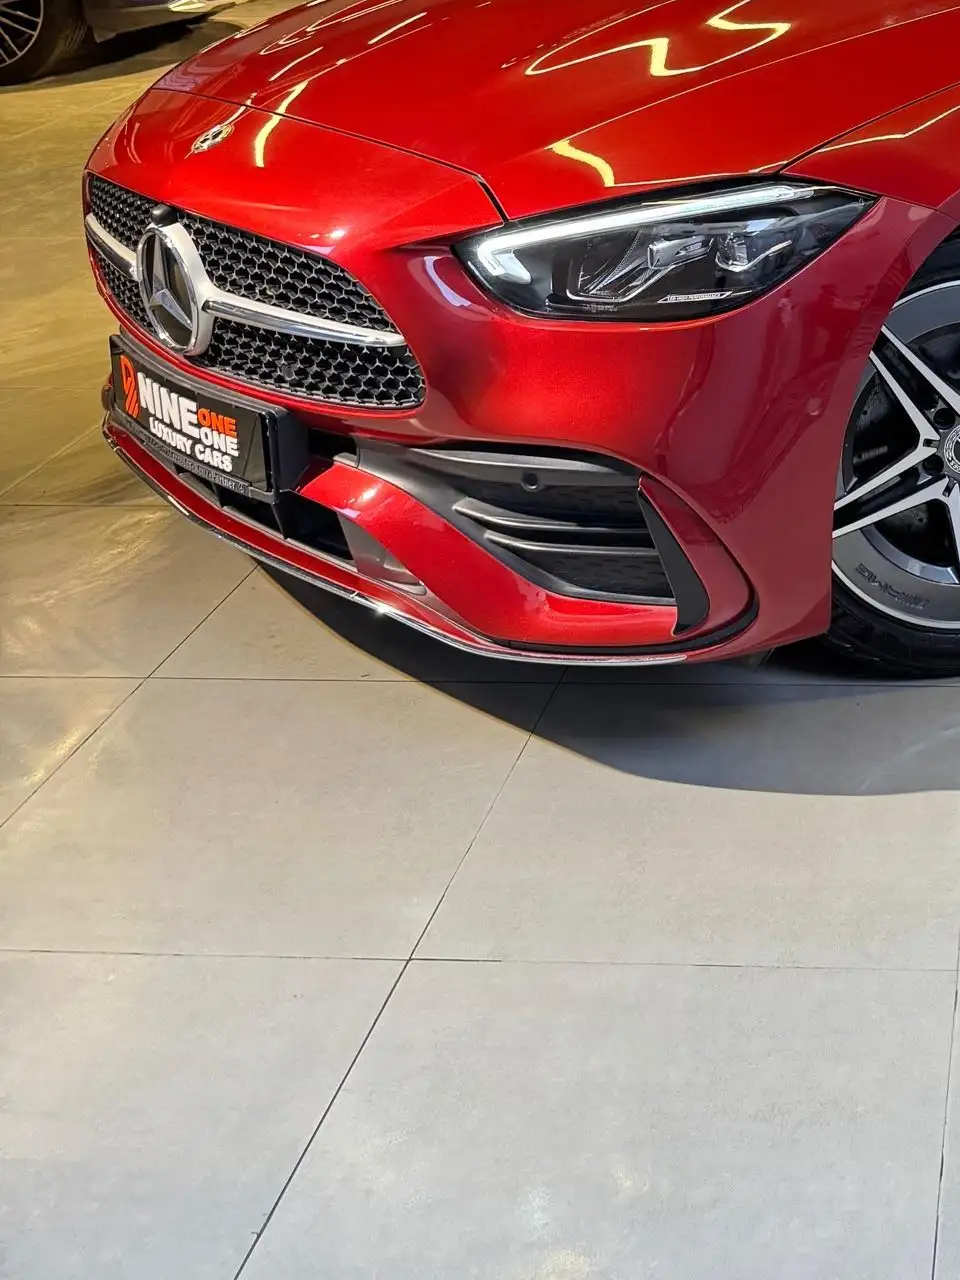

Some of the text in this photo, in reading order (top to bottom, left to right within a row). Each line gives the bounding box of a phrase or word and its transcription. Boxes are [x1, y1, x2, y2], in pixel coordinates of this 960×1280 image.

[137, 372, 201, 439] NINE
[197, 408, 237, 437] ONE
[149, 417, 193, 455] LUXURY
[194, 443, 233, 472] CARS
[200, 427, 239, 457] ONE
